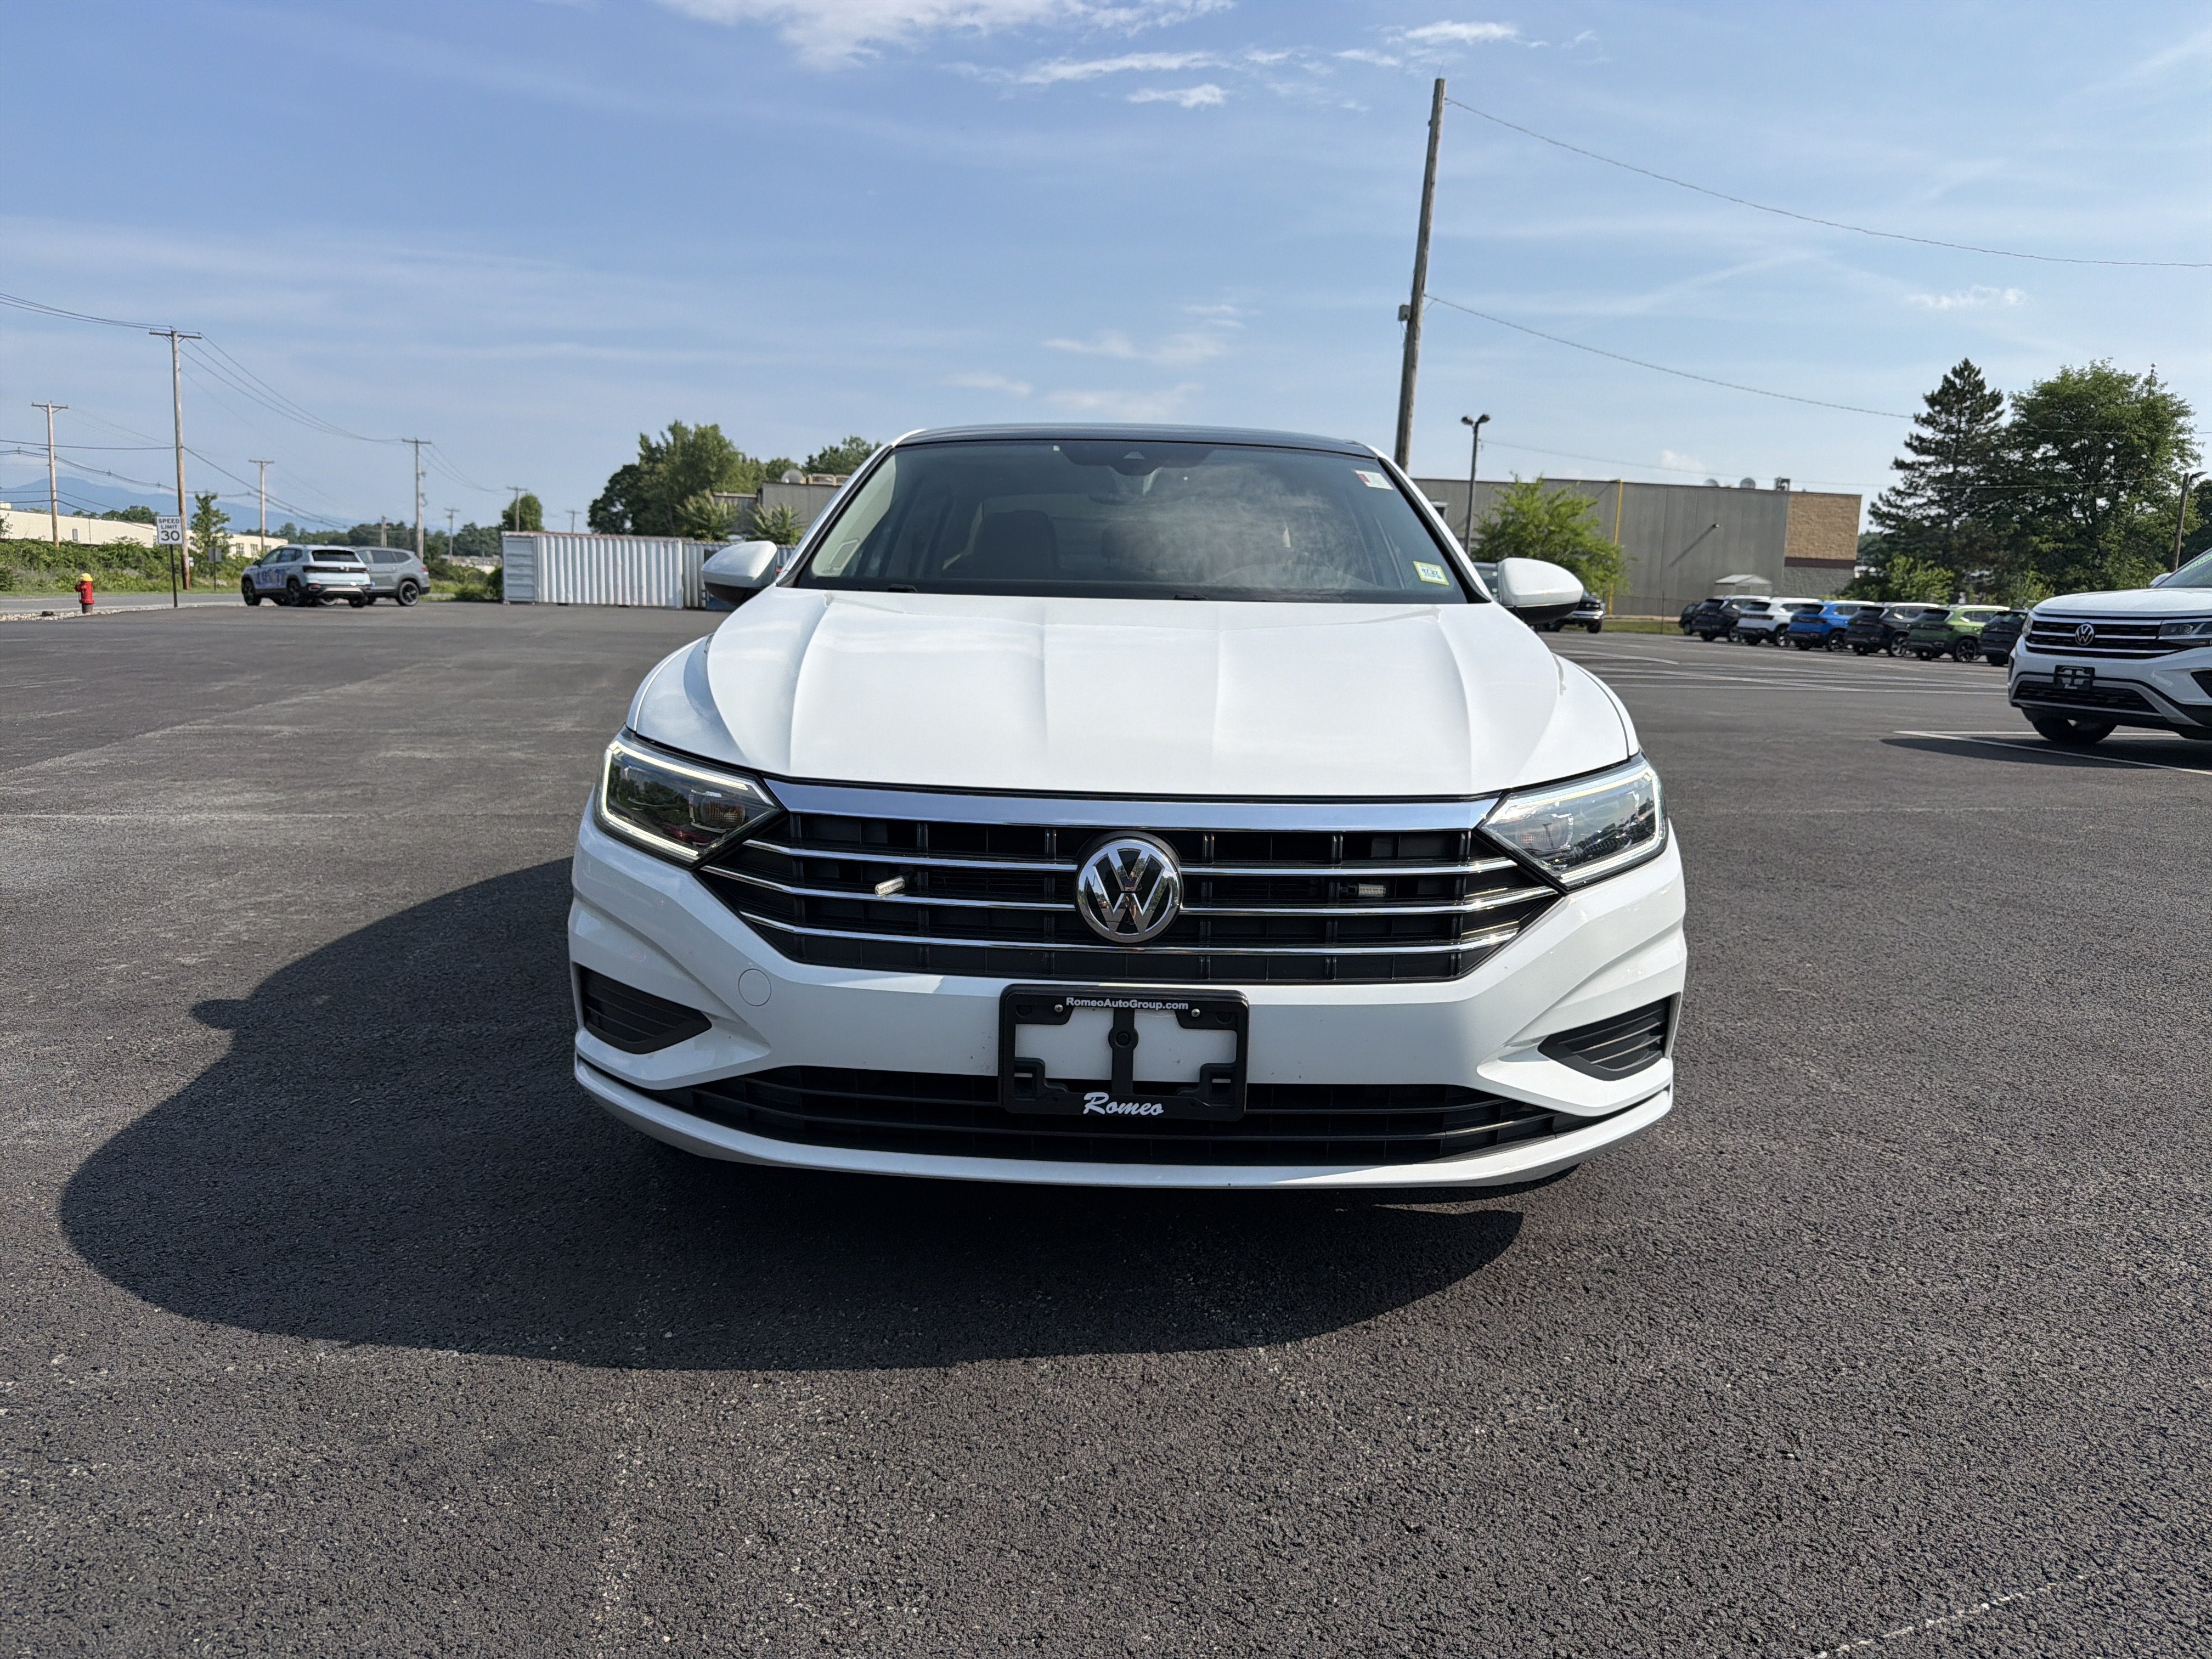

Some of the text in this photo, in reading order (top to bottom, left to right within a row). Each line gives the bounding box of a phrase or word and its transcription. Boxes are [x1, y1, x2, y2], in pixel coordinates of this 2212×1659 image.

[161, 531, 180, 541] 30
[1066, 997, 1189, 1010] RomeoAutoGroup.com
[1083, 1092, 1164, 1116] Romeo
